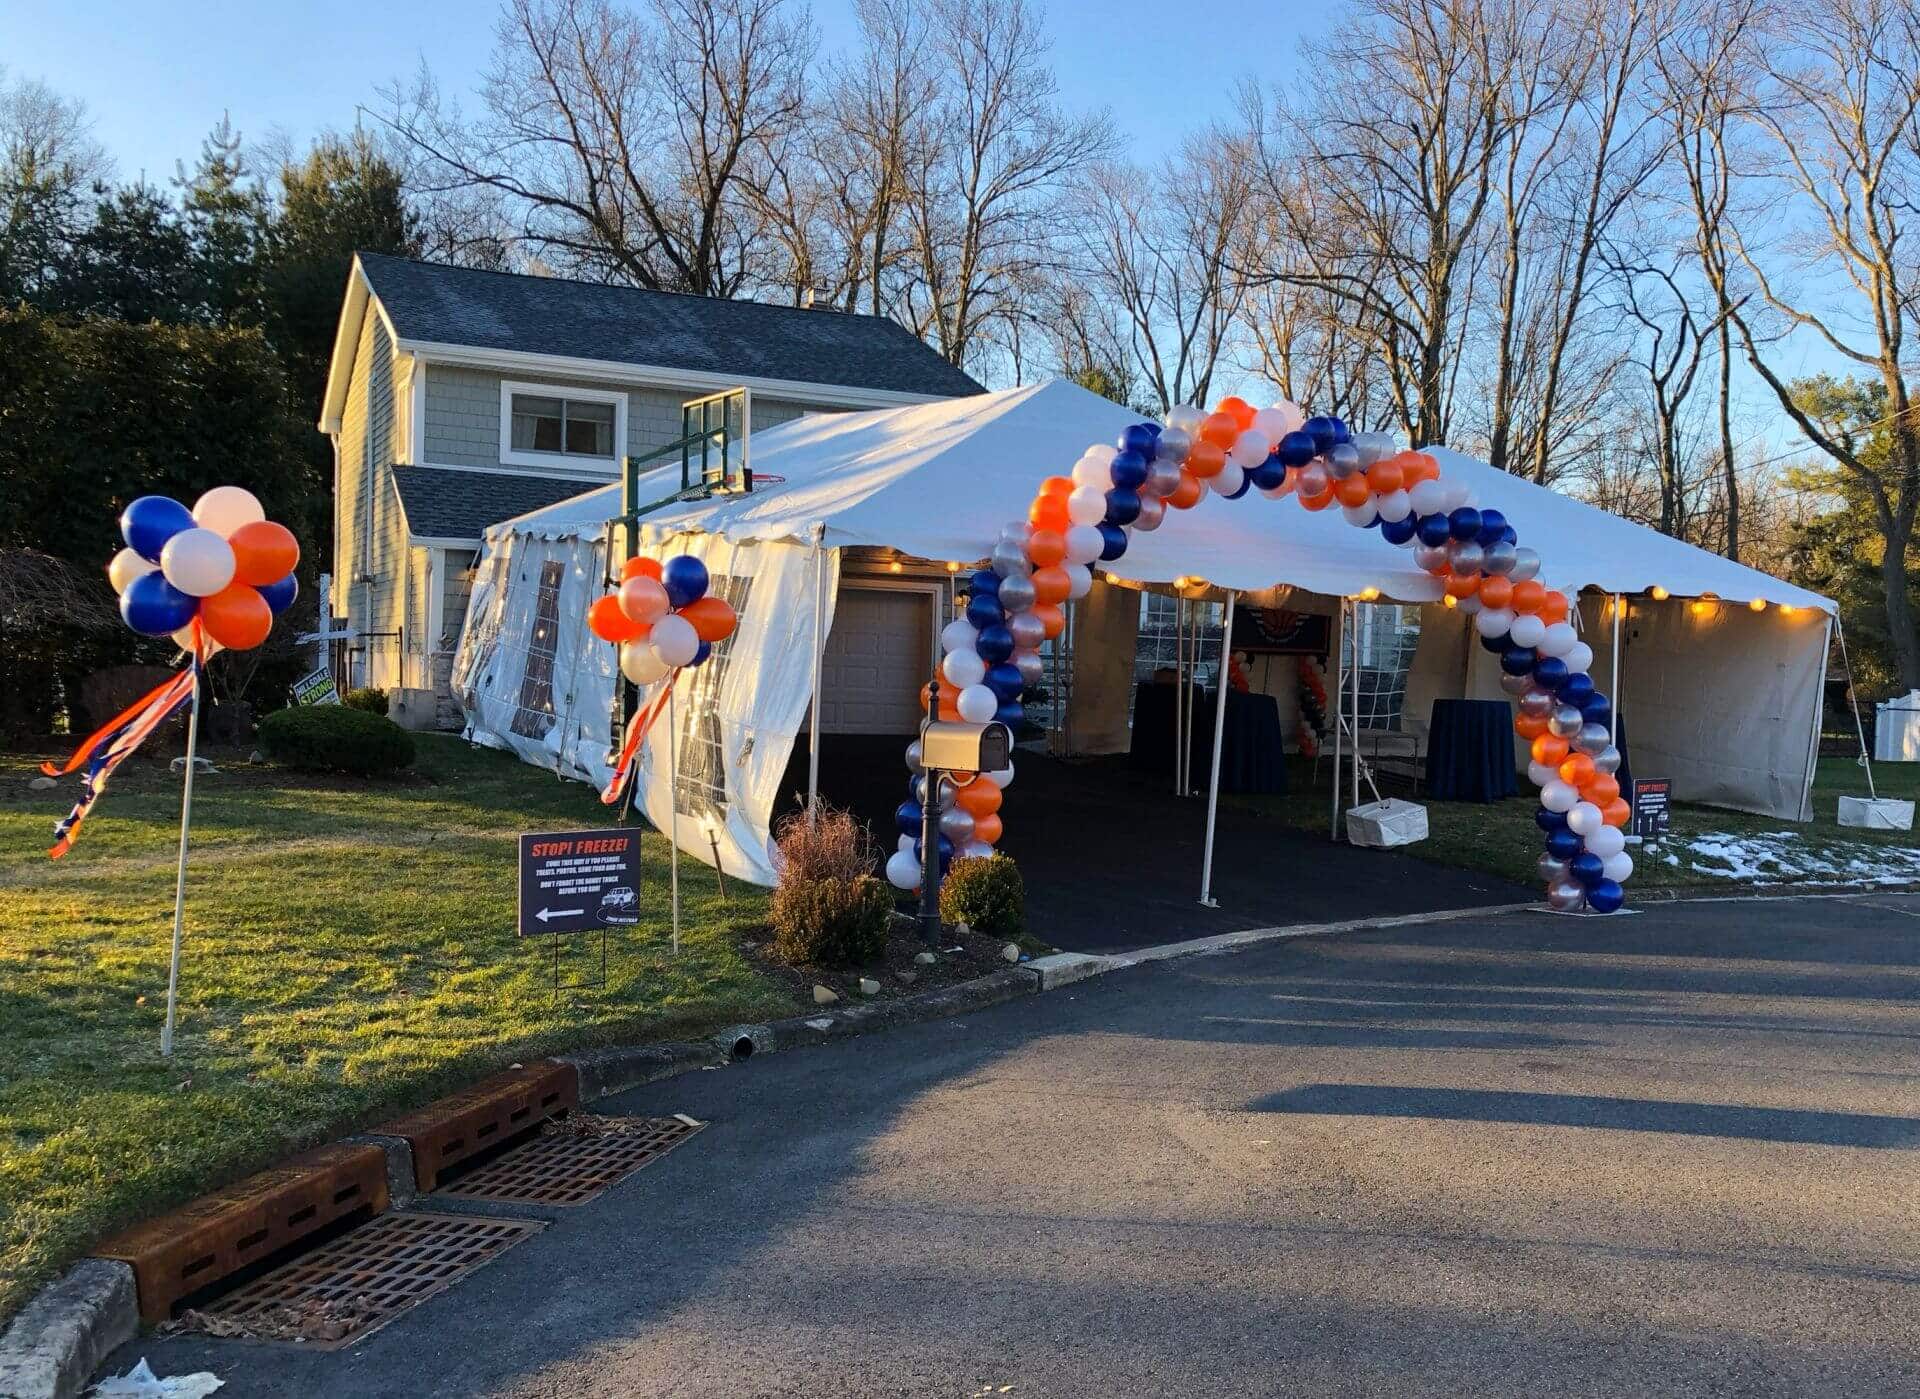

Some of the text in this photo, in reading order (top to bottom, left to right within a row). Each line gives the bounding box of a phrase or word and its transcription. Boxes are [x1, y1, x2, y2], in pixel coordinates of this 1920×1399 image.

[300, 679, 333, 704] STRONG
[532, 838, 628, 856] STOP! FREEZE!
